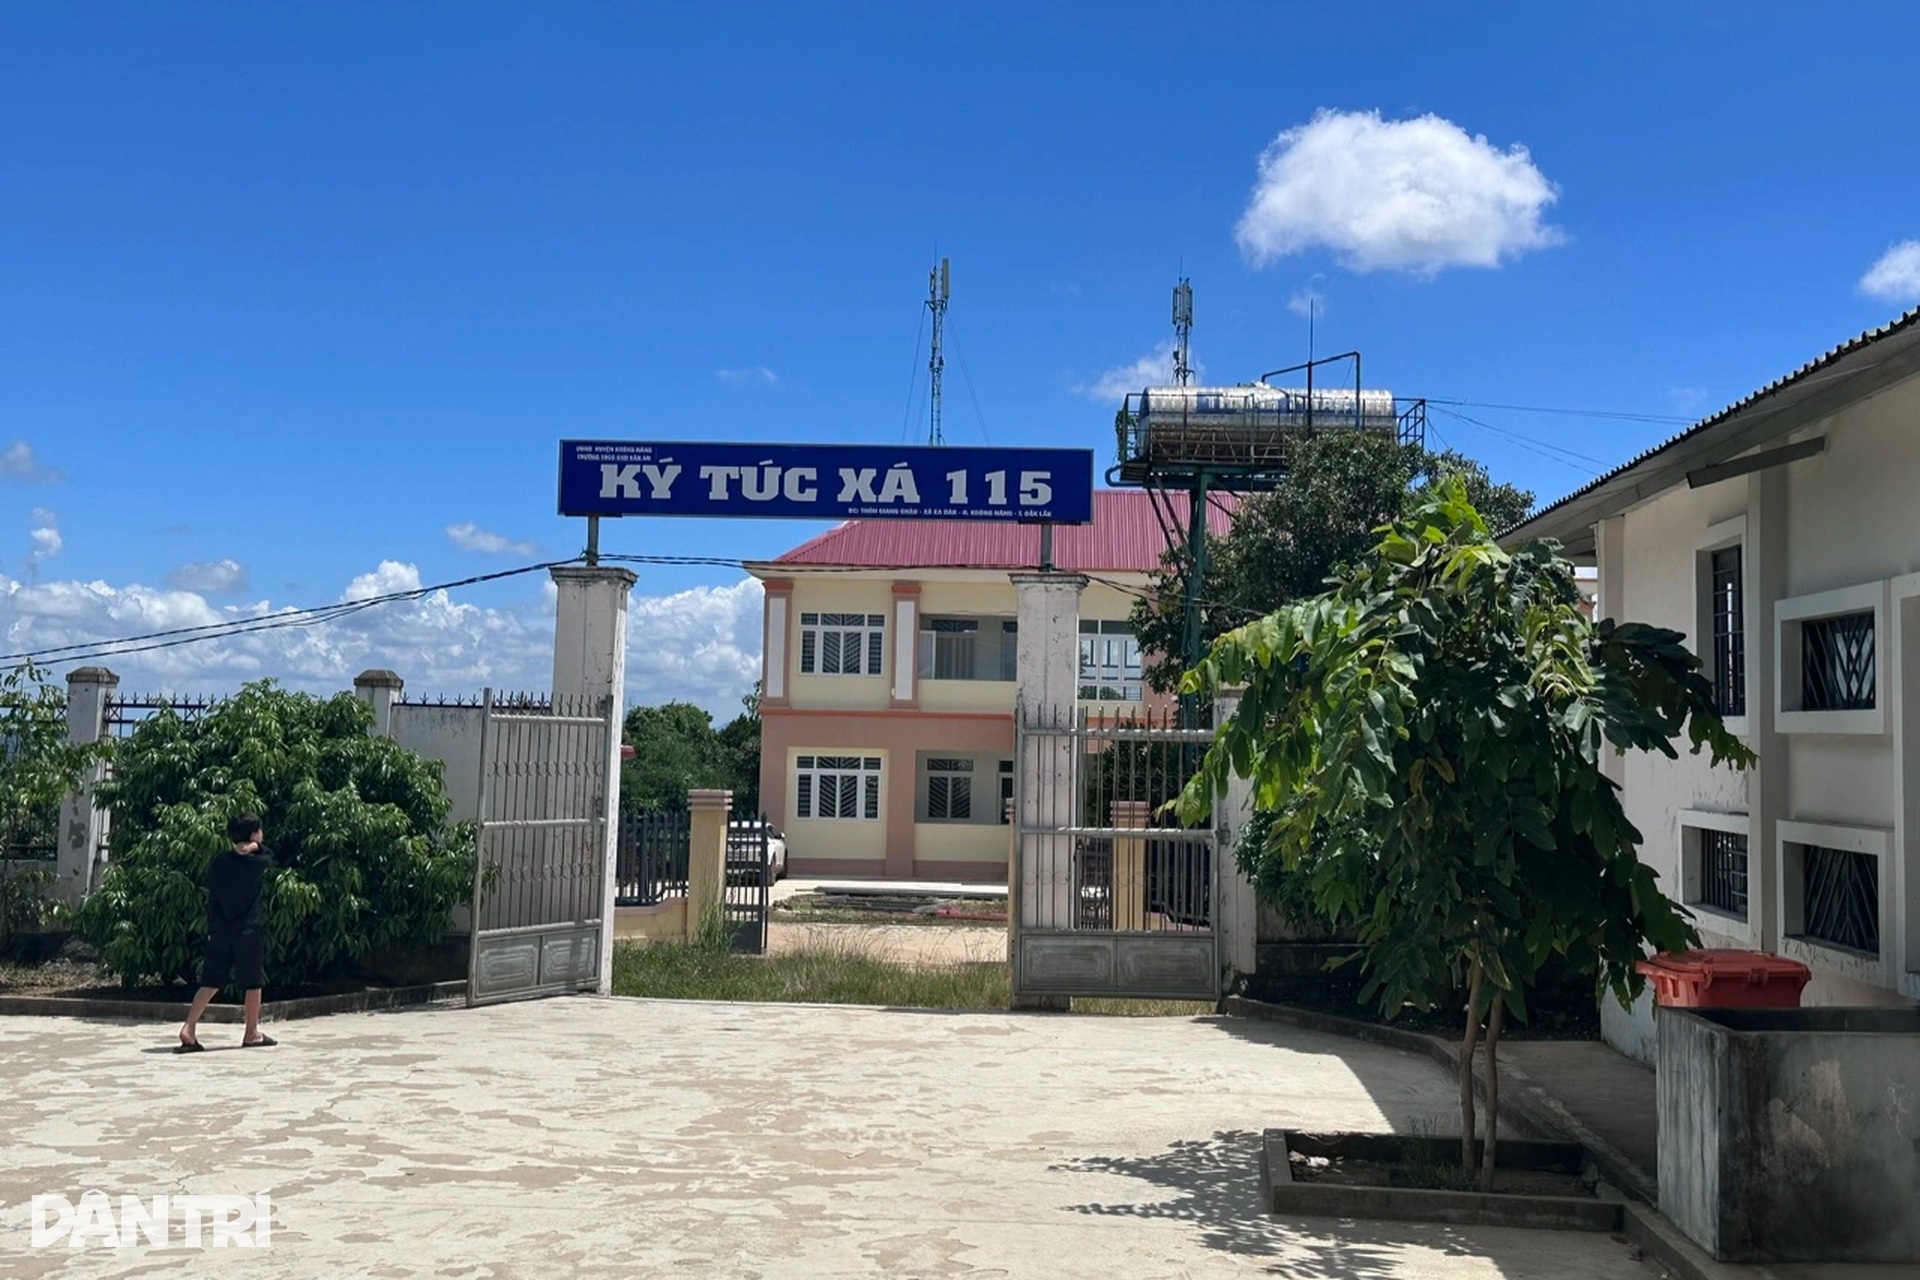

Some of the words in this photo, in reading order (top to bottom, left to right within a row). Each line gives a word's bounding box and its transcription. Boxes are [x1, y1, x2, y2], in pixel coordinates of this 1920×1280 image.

[600, 457, 682, 499] KÝ
[700, 459, 817, 501] TÚC
[837, 462, 920, 503] XÁ
